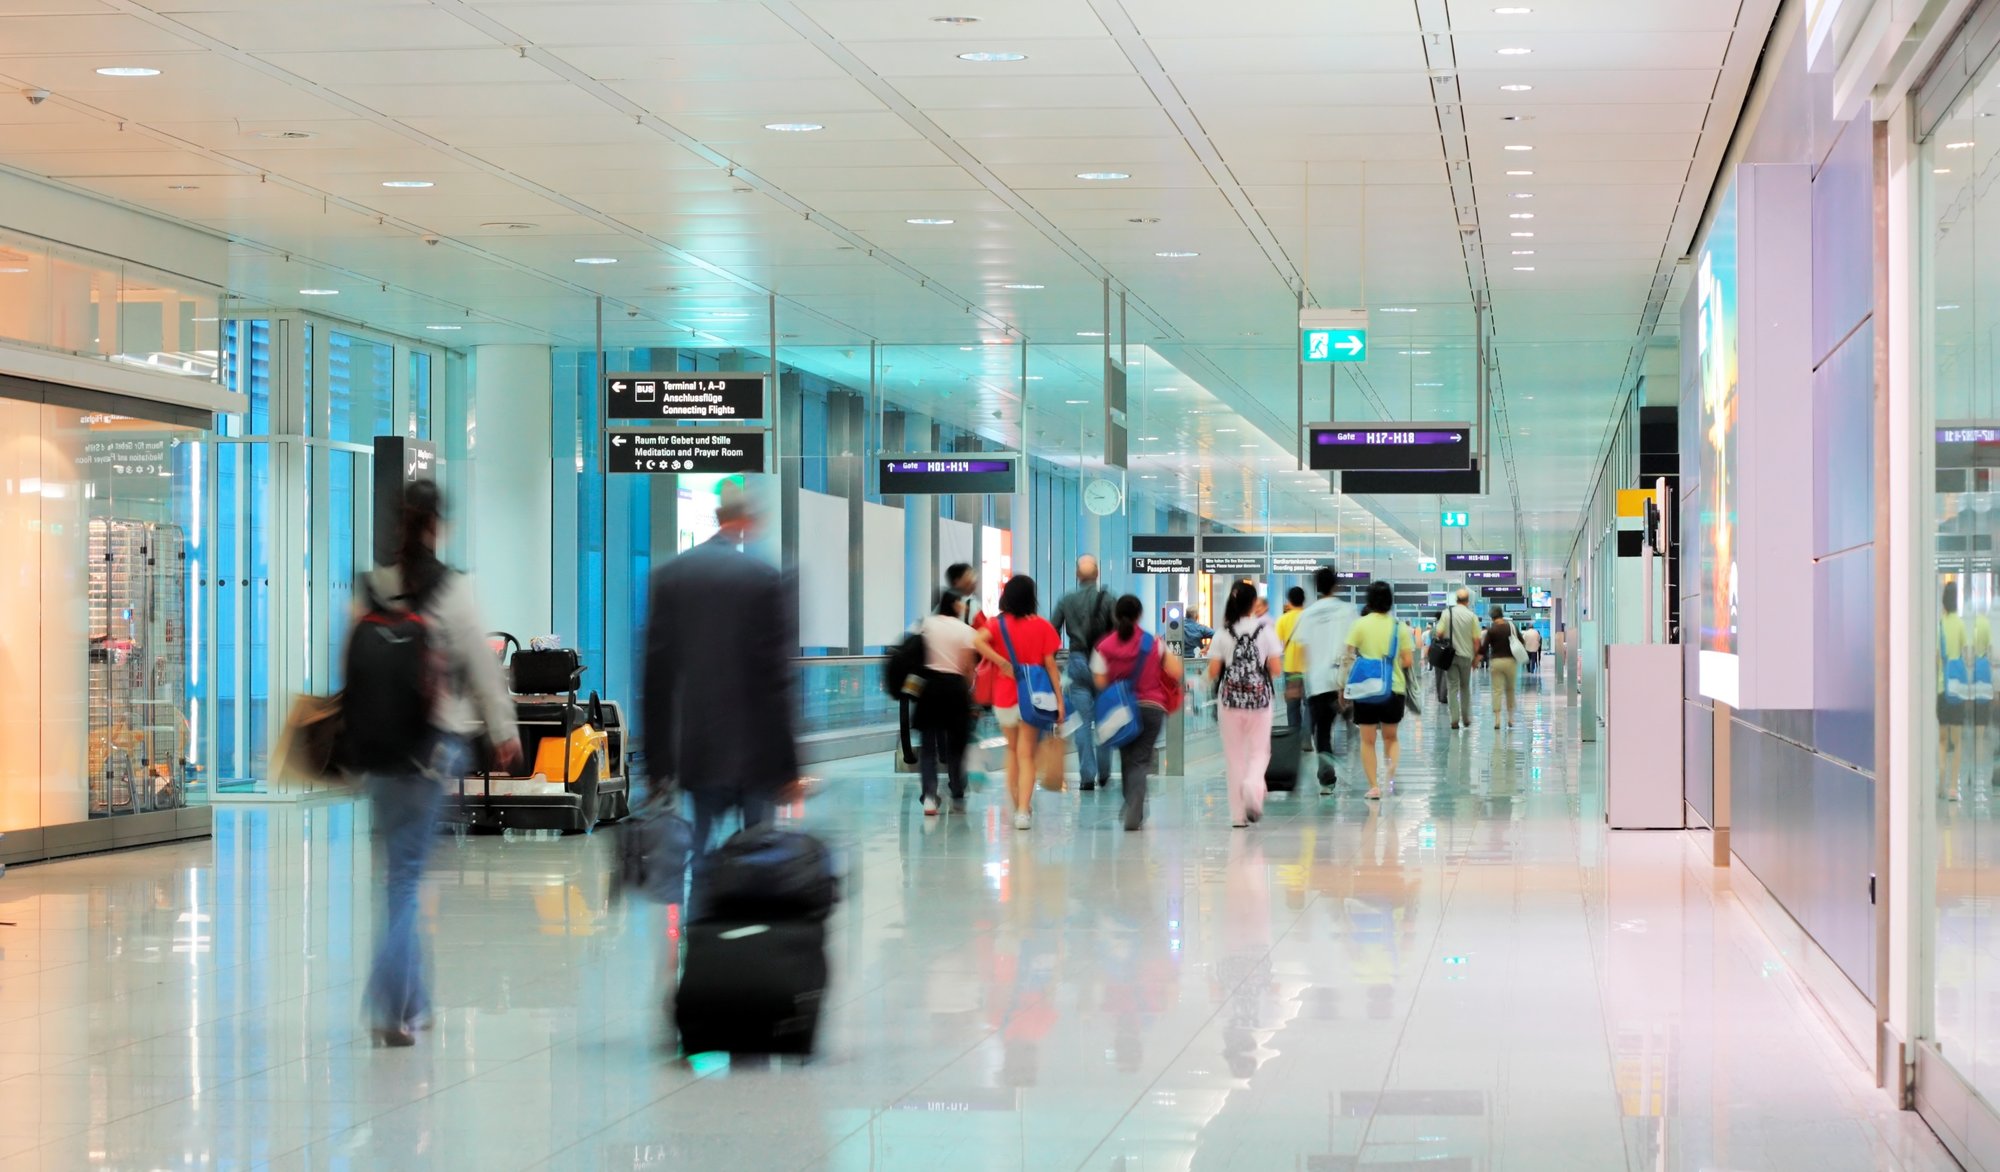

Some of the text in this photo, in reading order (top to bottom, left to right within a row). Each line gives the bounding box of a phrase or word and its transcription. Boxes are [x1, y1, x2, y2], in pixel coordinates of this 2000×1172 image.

[636, 385, 654, 393] BUS
[663, 381, 697, 391] Terminal
[698, 381, 706, 392] 1,
[663, 393, 723, 404] Anschlussflüge
[662, 405, 735, 416] Connecting Flights
[634, 435, 731, 445] Raum für Gebet und Stille
[1337, 432, 1415, 444] Gate H17-H18
[634, 448, 744, 458] Meditation and Prayer Room
[927, 462, 969, 472] H01-H14
[1146, 558, 1183, 566] Passkontrolle
[1146, 565, 1191, 573] Passport control
